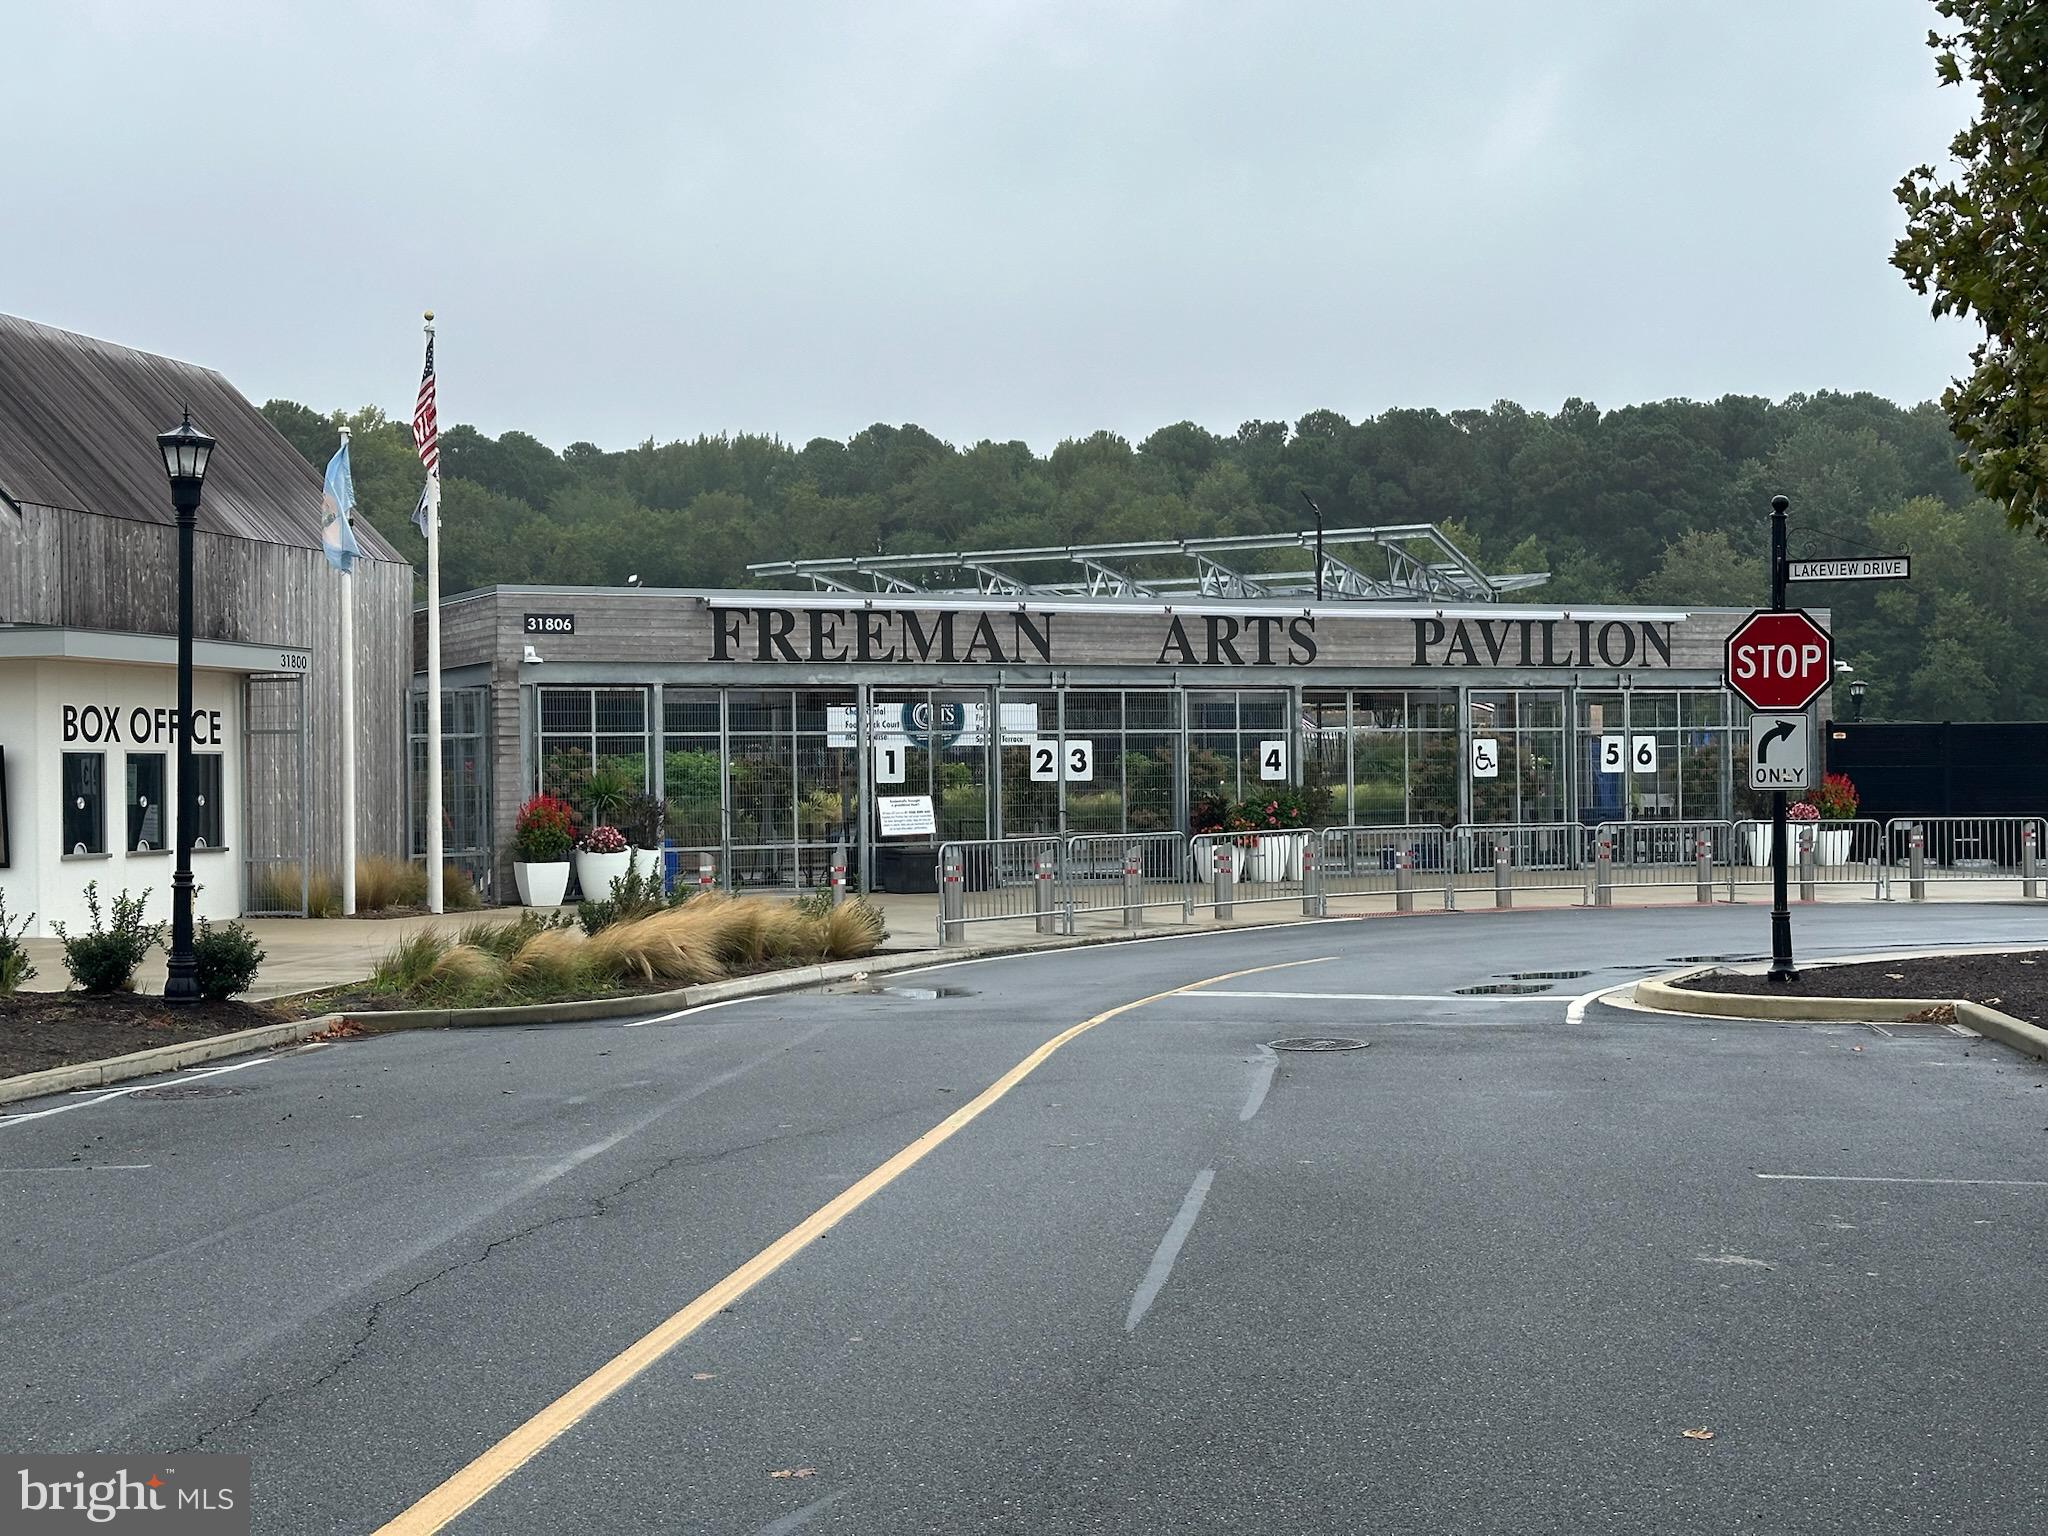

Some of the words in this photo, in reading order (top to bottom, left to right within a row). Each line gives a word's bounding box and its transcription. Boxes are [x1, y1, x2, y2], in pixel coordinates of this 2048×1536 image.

[1794, 562, 1859, 577] LAKEVIEW
[1863, 561, 1902, 575] DRIVE
[527, 617, 572, 631] 31806
[706, 606, 1056, 665] FREEMAN
[1156, 613, 1318, 667] ARTS
[1410, 617, 1676, 668] PAVILION
[280, 654, 307, 669] 31800
[1736, 643, 1822, 679] STOP
[62, 704, 122, 743] BOX
[129, 706, 222, 745] OFFCE
[885, 749, 895, 775] 1
[1036, 748, 1054, 773] 2
[1070, 748, 1087, 773] 3
[1264, 748, 1282, 772] 4
[1606, 743, 1619, 765] 5
[1637, 743, 1652, 765] 6
[1756, 767, 1804, 783] ONLY
